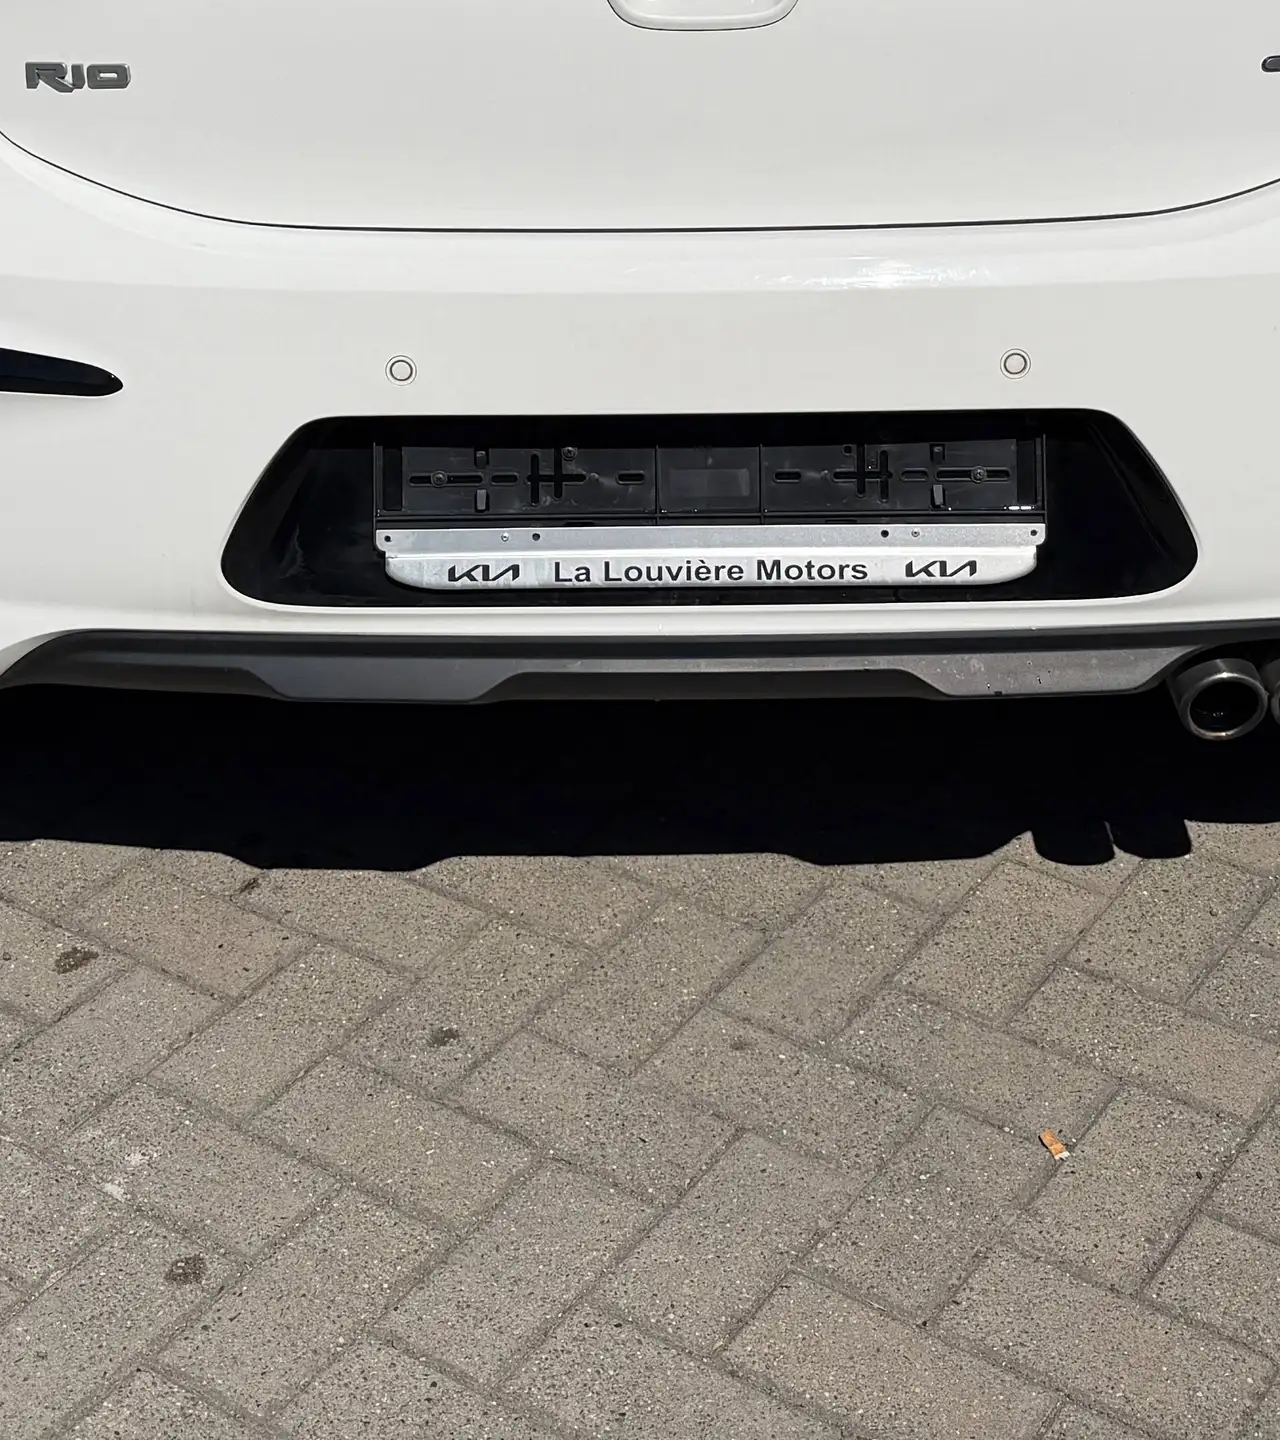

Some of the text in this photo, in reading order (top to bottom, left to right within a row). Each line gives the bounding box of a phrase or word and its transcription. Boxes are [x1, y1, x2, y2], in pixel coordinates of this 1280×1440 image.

[24, 61, 132, 93] RIO
[447, 559, 978, 583] KIA La Louvière Motors KIA
